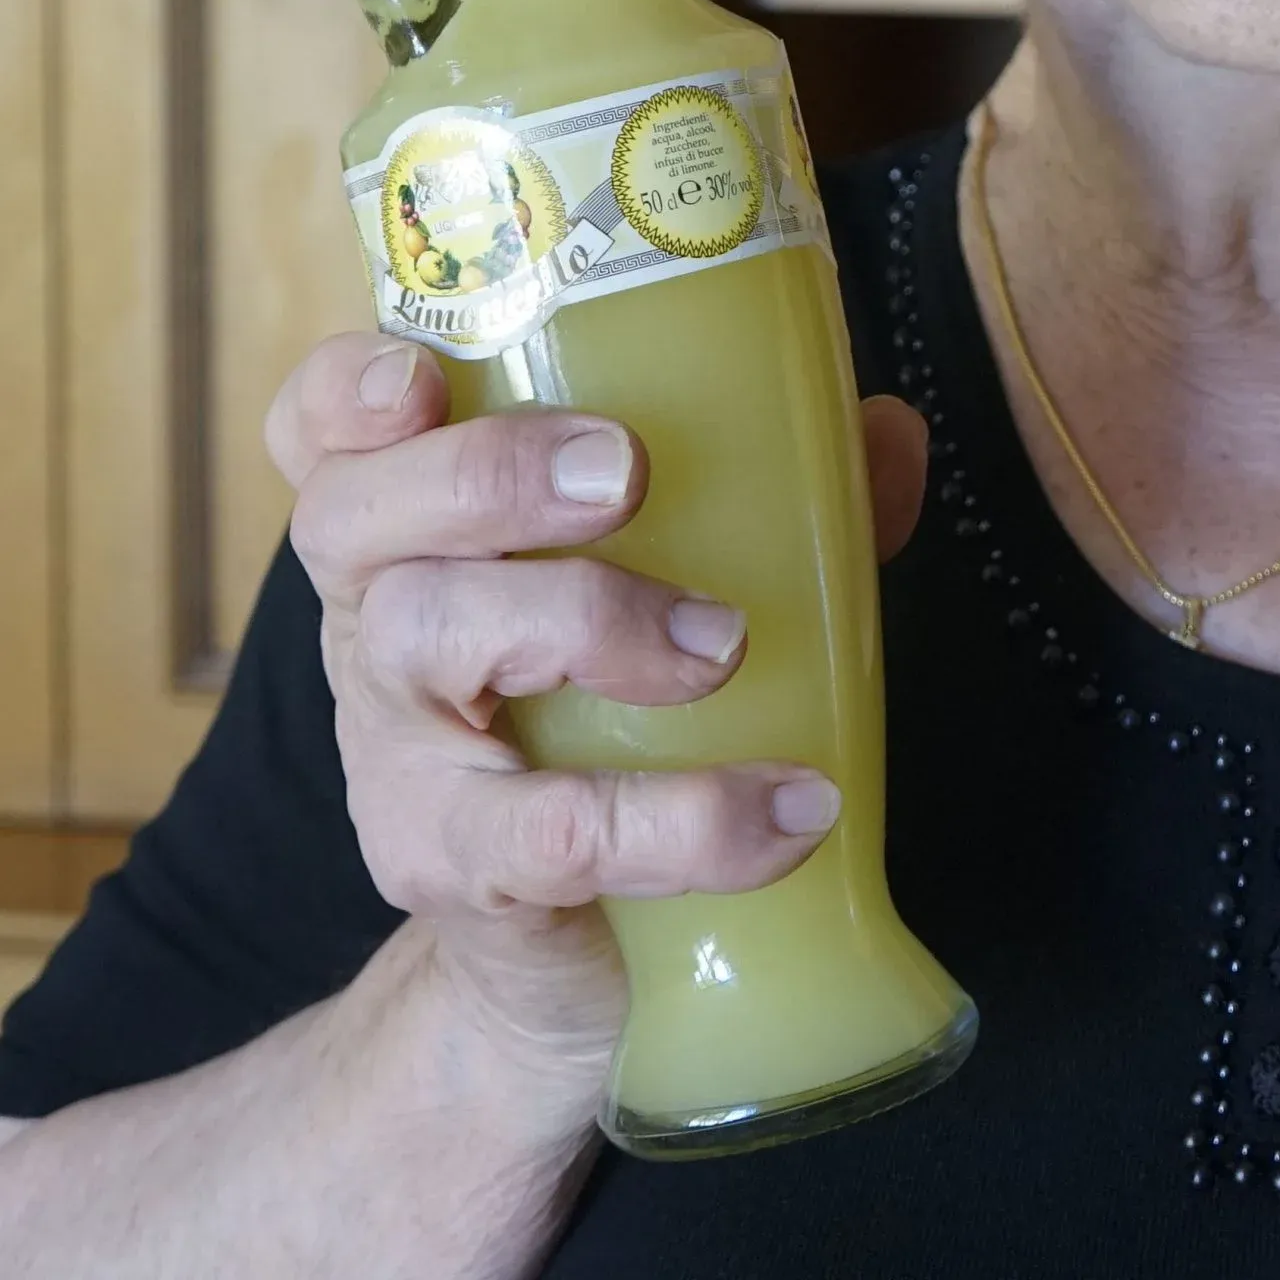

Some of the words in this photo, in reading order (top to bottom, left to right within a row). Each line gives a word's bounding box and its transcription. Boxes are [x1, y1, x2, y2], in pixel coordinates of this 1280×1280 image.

[651, 132, 684, 146] acqua,
[686, 122, 716, 137] alcool,
[653, 112, 710, 133] Ingredienti:
[654, 156, 684, 169] infusi
[685, 151, 696, 162] di
[697, 145, 723, 159] bucce
[664, 138, 711, 155] zucchero,
[668, 167, 679, 178] di
[640, 189, 663, 217] 50
[705, 169, 738, 201] 30%
[392, 244, 594, 331] Limolo
